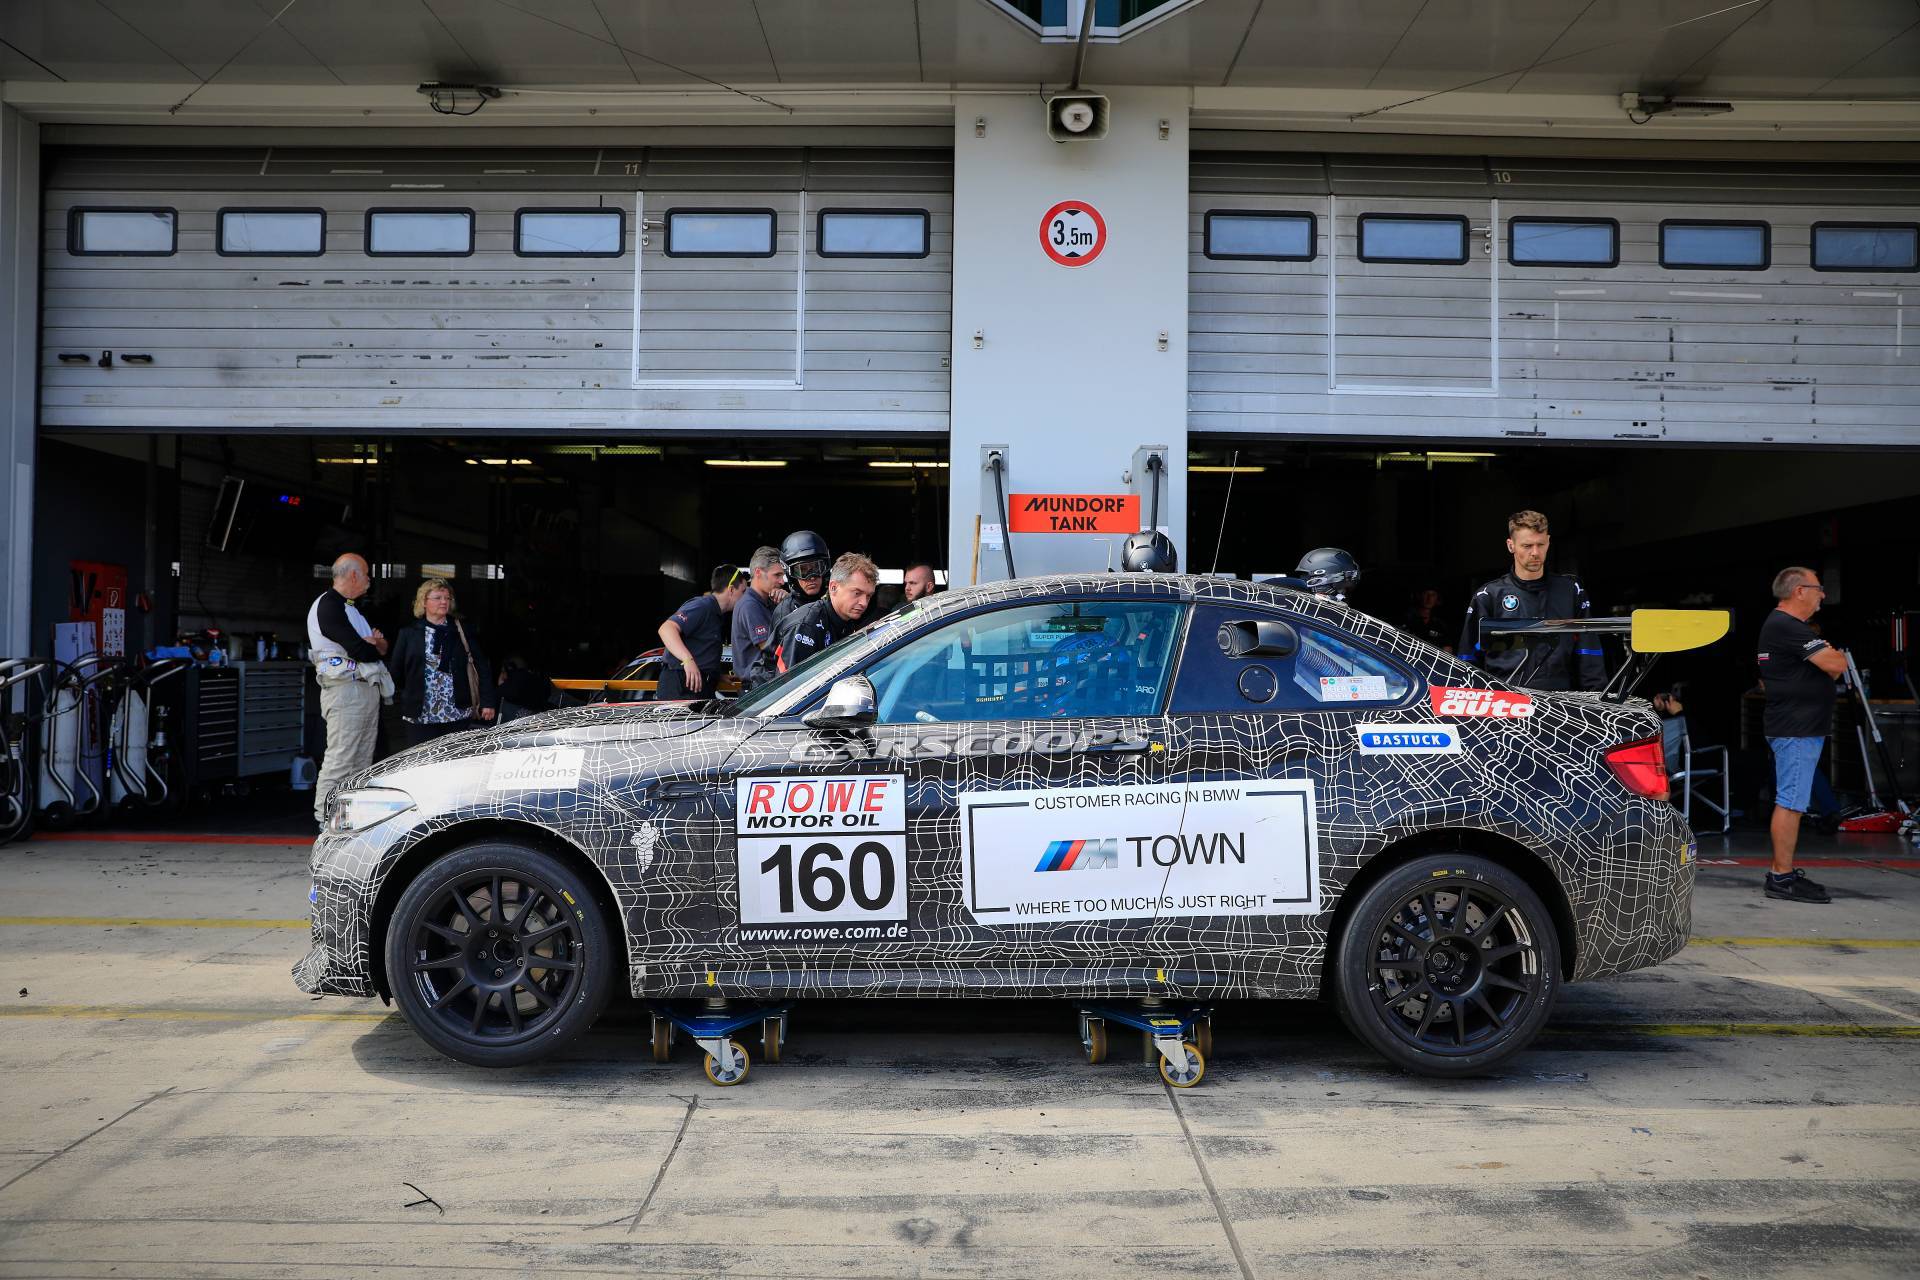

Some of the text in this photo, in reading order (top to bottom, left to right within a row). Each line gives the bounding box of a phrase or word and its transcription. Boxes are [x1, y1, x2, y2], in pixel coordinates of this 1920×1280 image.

[1493, 171, 1511, 183] 10
[1024, 497, 1125, 513] MUNDORF
[1050, 516, 1098, 531] TANK
[1443, 689, 1494, 700] sport
[1439, 699, 1537, 718] auto
[1372, 734, 1441, 746] BASTUCK
[521, 751, 558, 766] AM
[494, 767, 577, 780] solutions
[745, 779, 891, 814] ROWE
[1034, 788, 1240, 810] CUSTOMER RACING IN BMW
[746, 814, 881, 829] MOTOR OIL
[1126, 832, 1245, 868] TOWN
[761, 841, 895, 913] 160
[1016, 894, 1267, 916] WHERE TOO MUCH IS JUST RIGHT
[740, 923, 908, 941] www.rowe.com.de
